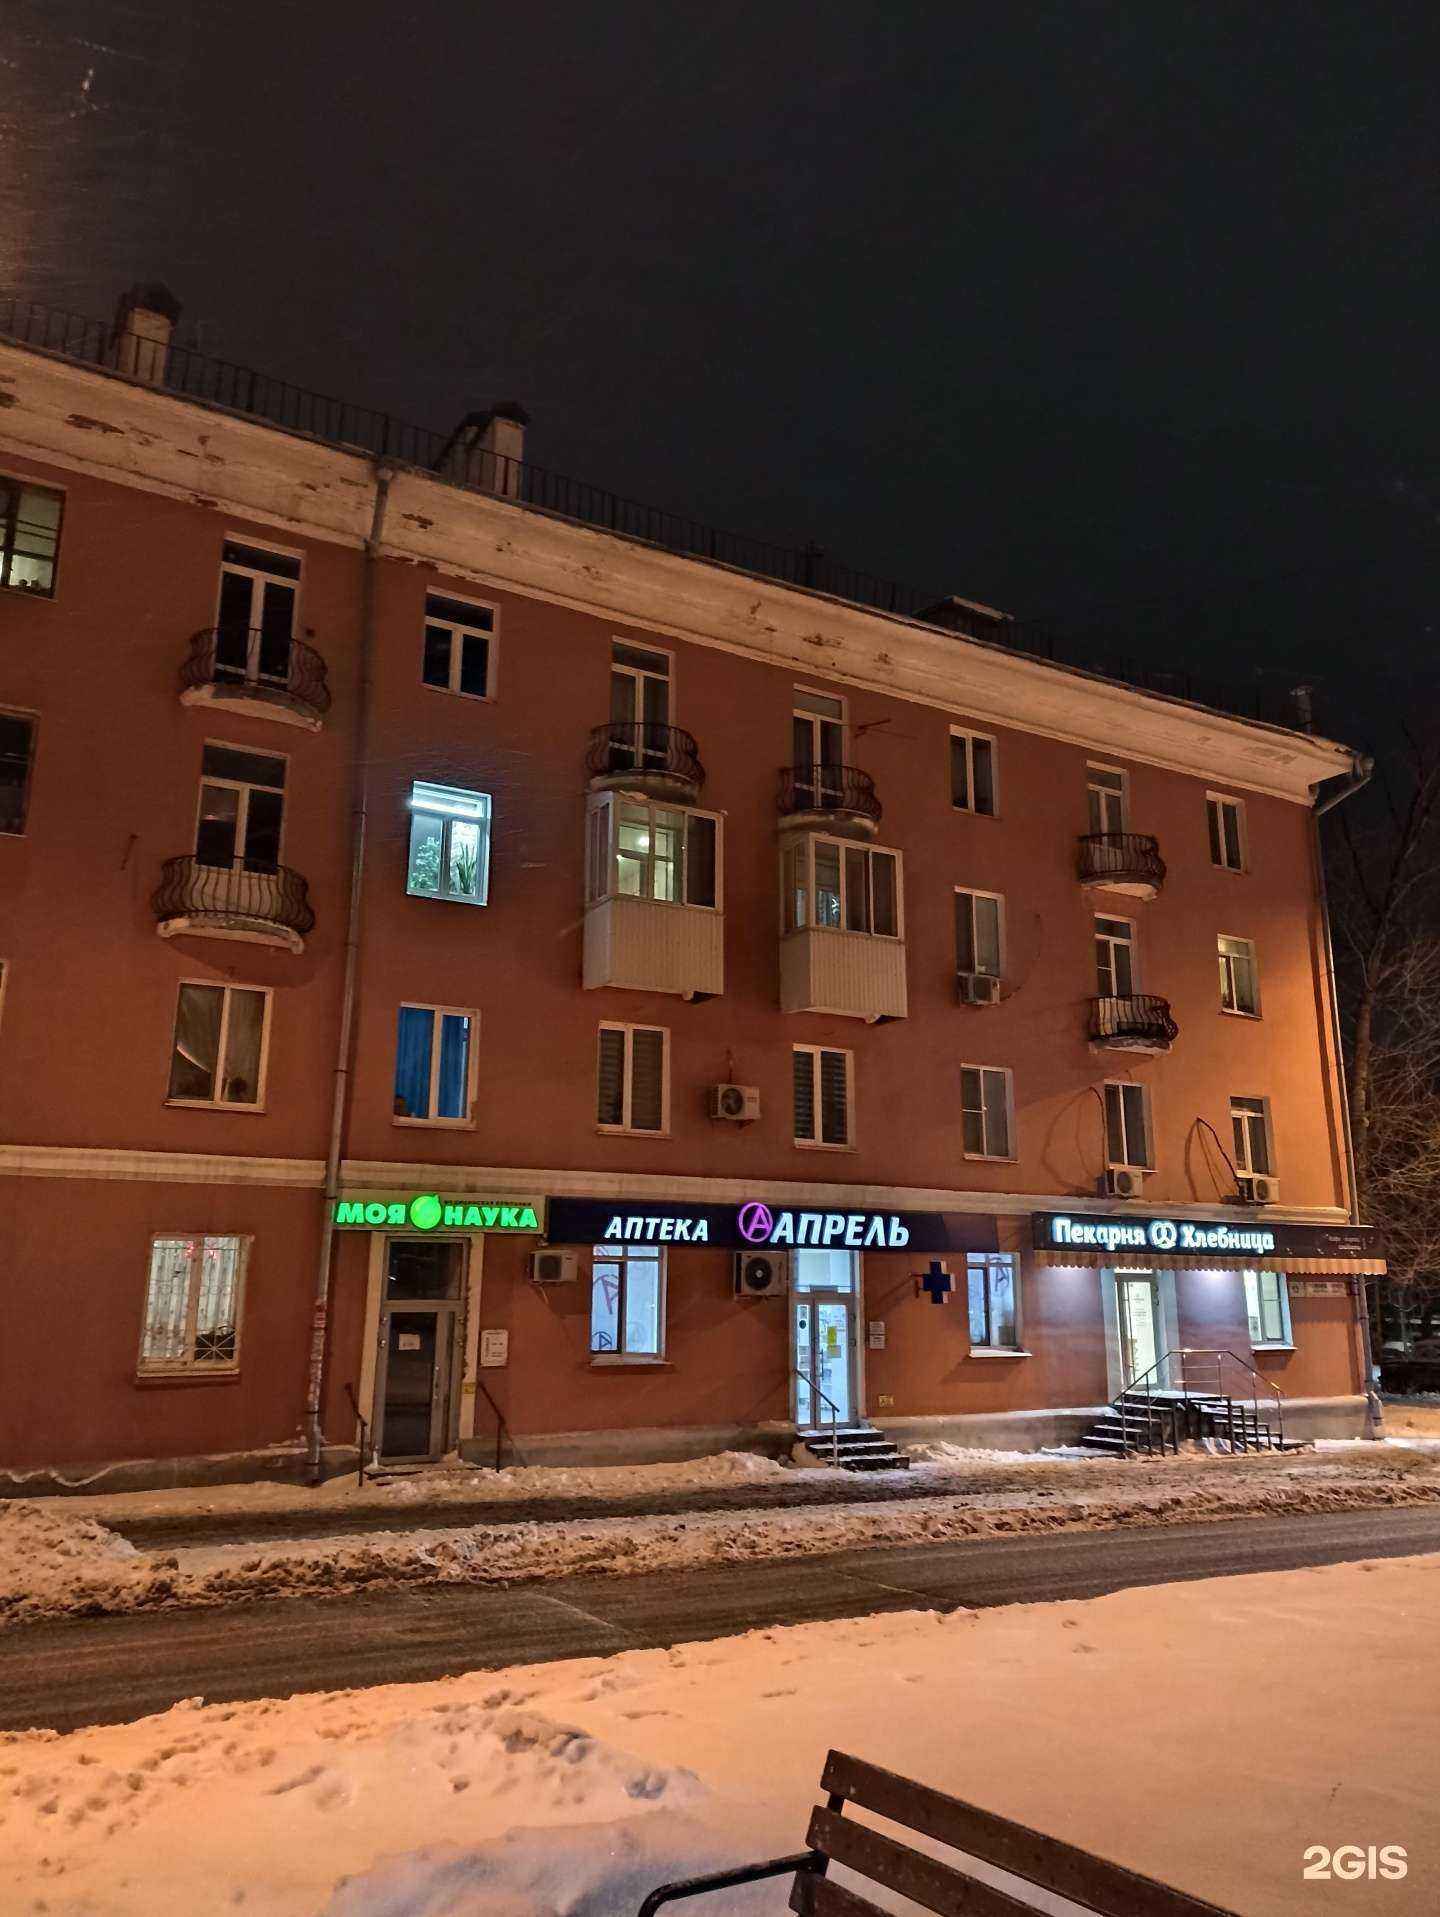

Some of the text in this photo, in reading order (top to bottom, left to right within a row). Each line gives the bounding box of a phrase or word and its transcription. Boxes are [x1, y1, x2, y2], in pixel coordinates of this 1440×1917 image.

[337, 1203, 538, 1228] МОЯ НАУКА
[605, 1217, 708, 1241] АПТЕКА
[770, 1213, 909, 1247] АПРЕЛЬ
[1052, 1217, 1275, 1253] Пекарня Хлебница
